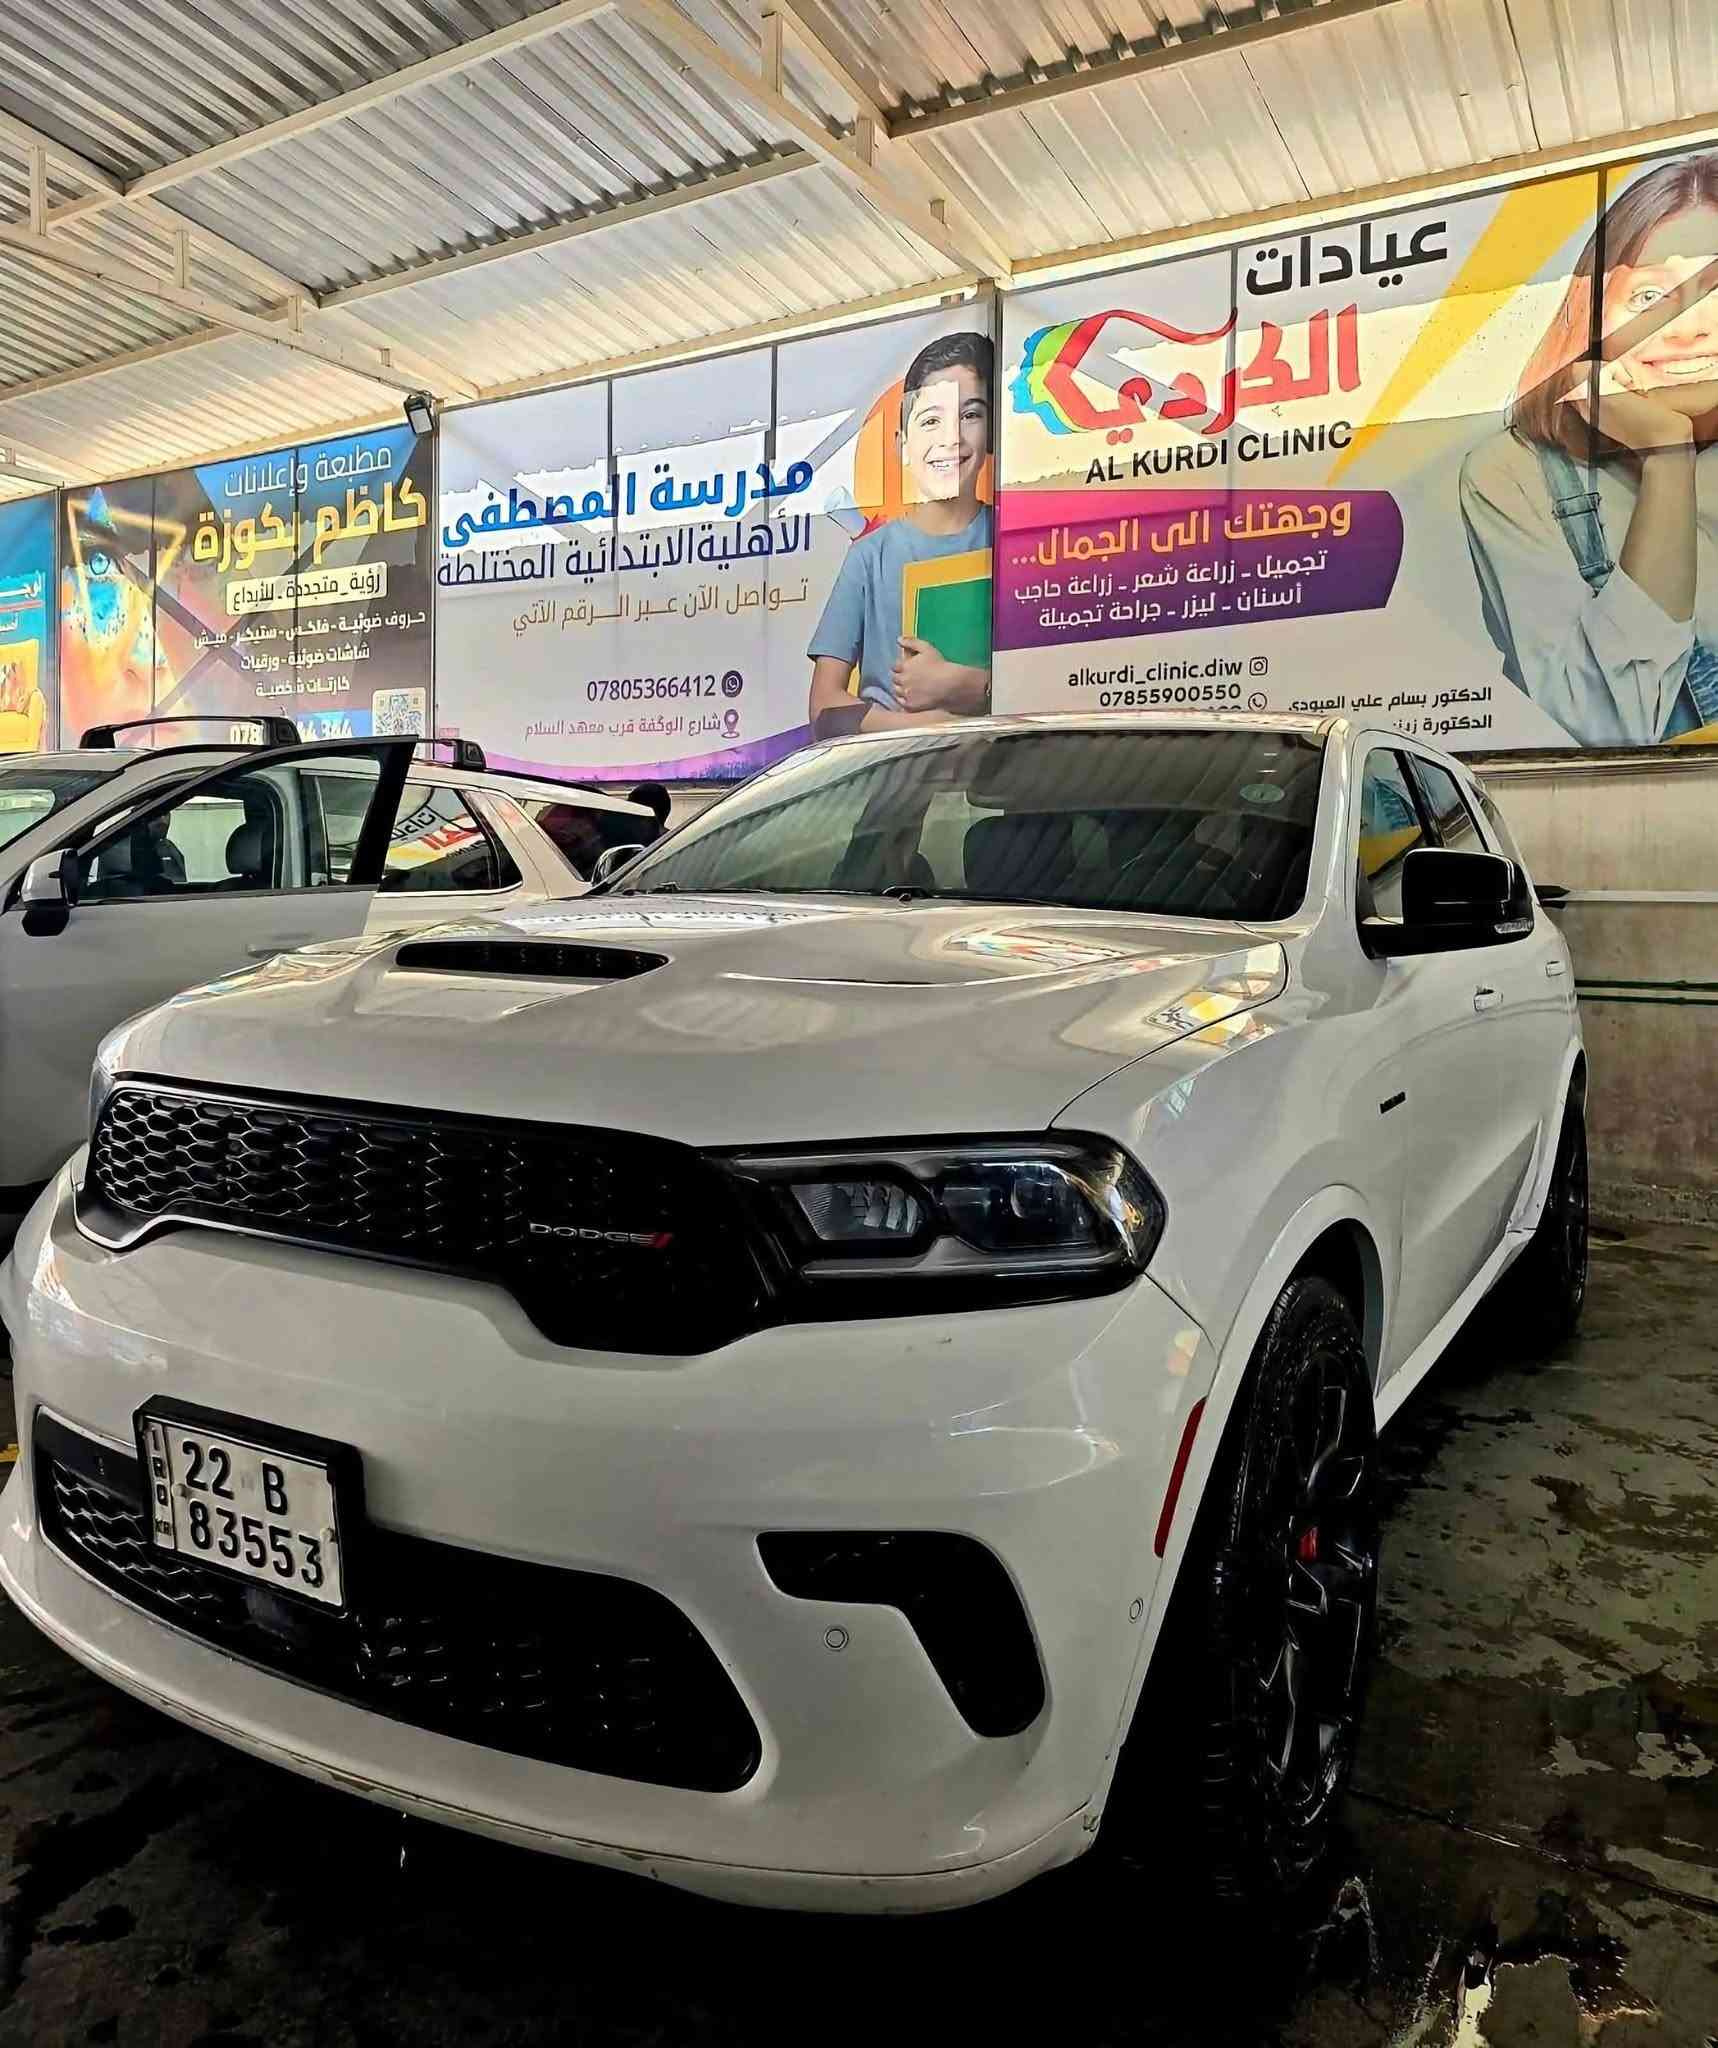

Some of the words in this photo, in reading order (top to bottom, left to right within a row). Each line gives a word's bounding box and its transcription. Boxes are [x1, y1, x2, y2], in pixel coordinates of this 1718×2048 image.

[1245, 220, 1448, 296] عيادات
[1042, 303, 1361, 445] الكردي
[315, 445, 392, 482] مطبعة
[1085, 456, 1123, 484] AL
[1132, 439, 1227, 478] KURDI
[1237, 421, 1352, 462] CLINIC
[224, 457, 309, 497] وإعلانات
[650, 461, 813, 517] مدرسة
[313, 477, 427, 565] كاظم
[443, 472, 636, 547] المصطفى
[1224, 500, 1352, 540] وجهتك
[438, 543, 554, 586] المختلطة
[1186, 559, 1235, 585] زراعة
[1256, 549, 1328, 579] تجميل
[1014, 578, 1061, 602] حاجب
[1068, 573, 1113, 599] زراعة
[1132, 564, 1178, 594] شعر
[634, 598, 677, 622] عبر
[726, 577, 809, 615] تواصل
[1181, 592, 1216, 618] ليزر
[1236, 583, 1302, 611] أسنان
[562, 592, 629, 631] الرقم
[1109, 600, 1161, 622] جراحة
[1068, 658, 1243, 687] alkurdi_clinic.diw
[587, 675, 716, 701] 07805366412
[1099, 683, 1242, 707] 07855900550
[1388, 692, 1427, 711] بسام
[1432, 687, 1492, 708] الدكتور
[1351, 694, 1383, 711] علي
[525, 720, 564, 742] السلام
[568, 721, 604, 735] معهد
[608, 720, 634, 737] قرب
[688, 712, 721, 736] شارع
[1423, 714, 1492, 735] الدكتورة
[529, 1223, 656, 1246] DODGE
[182, 1440, 234, 1500] 22
[262, 1462, 288, 1516] B
[189, 1500, 323, 1588] 83553
